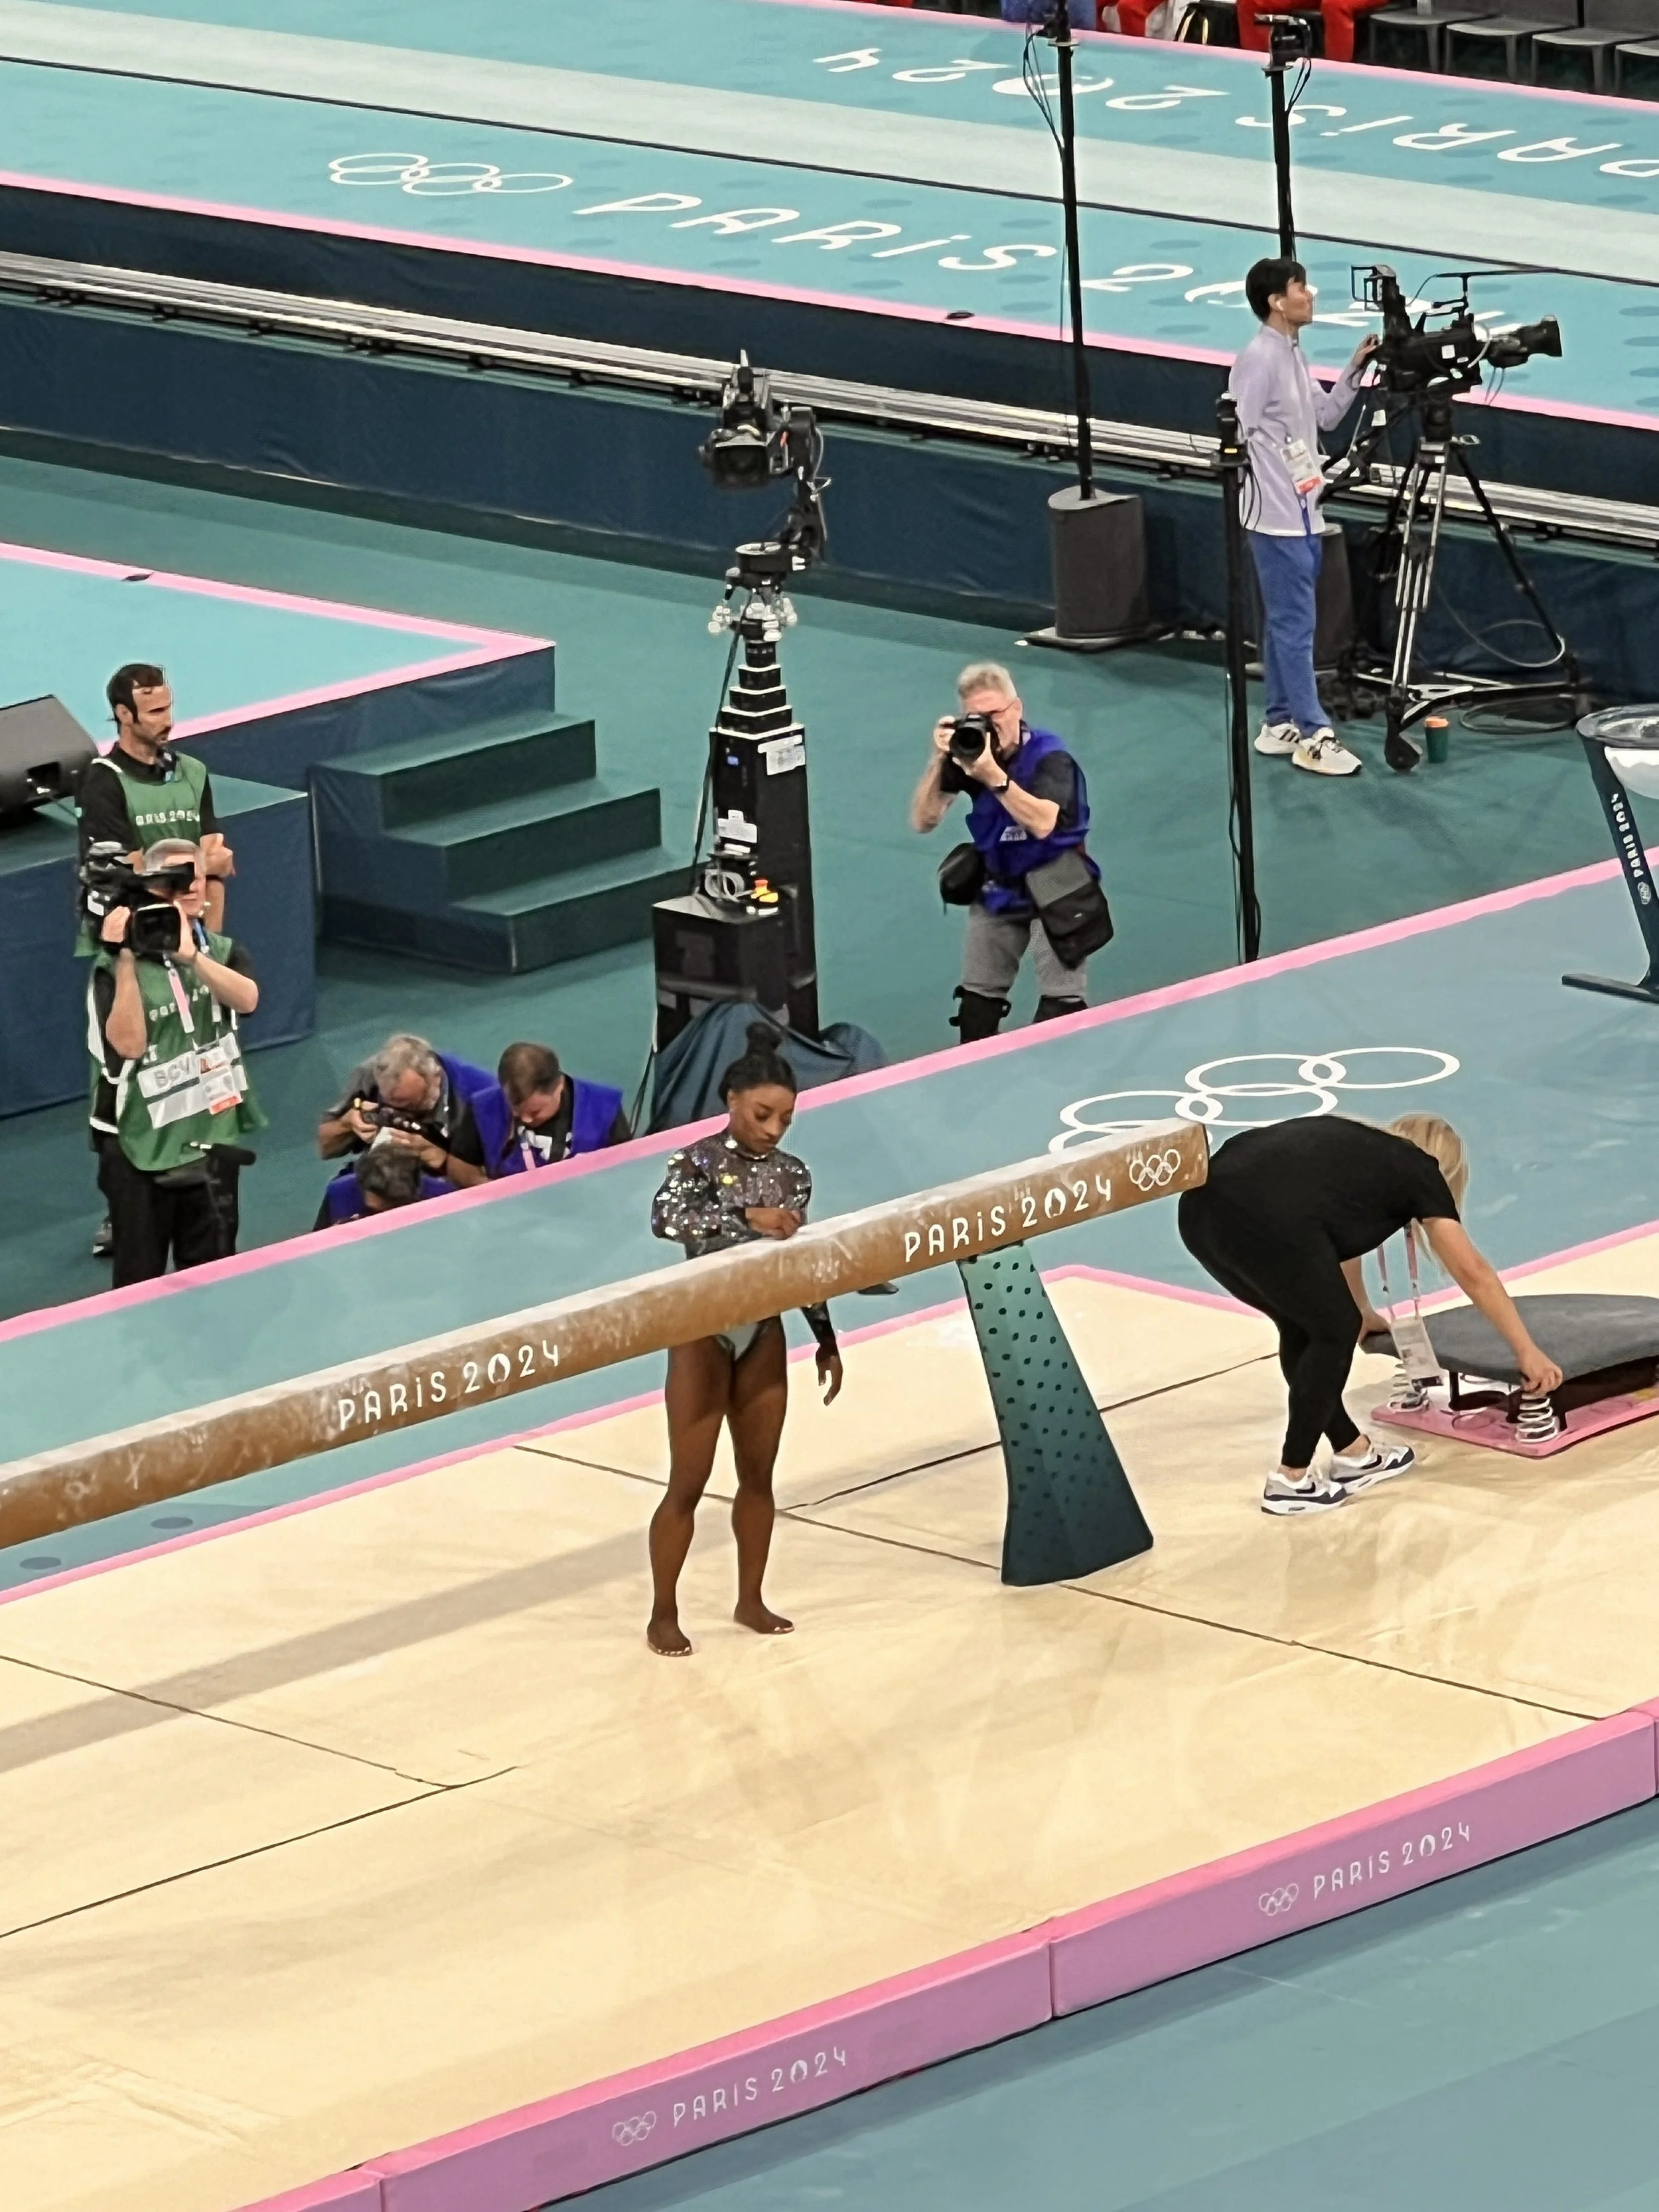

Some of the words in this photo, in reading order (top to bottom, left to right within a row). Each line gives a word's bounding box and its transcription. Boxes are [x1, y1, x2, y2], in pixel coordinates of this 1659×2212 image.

[1021, 1173, 1112, 1228] 2024
[463, 1339, 559, 1394] 2024
[1313, 1850, 1390, 1901] PARIS
[1402, 1822, 1470, 1866] 2024
[673, 2077, 757, 2128] PARIS
[770, 2046, 846, 2093] 2024
